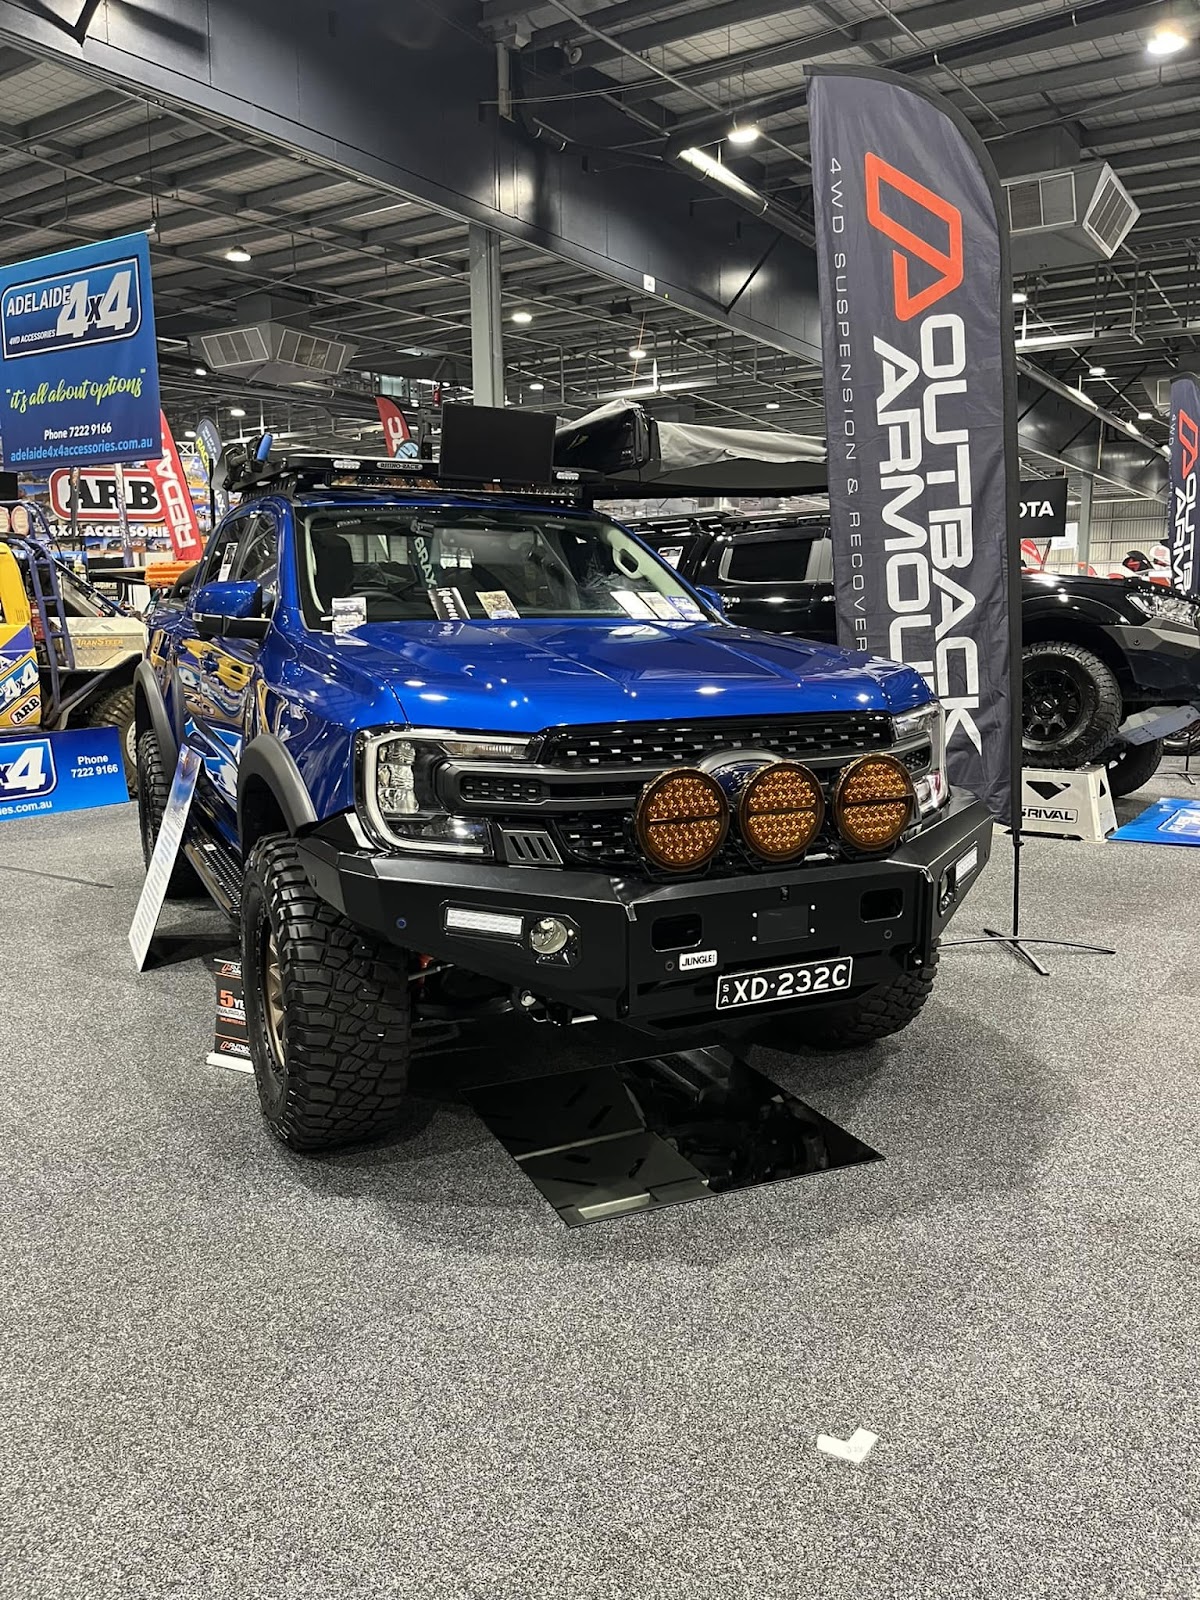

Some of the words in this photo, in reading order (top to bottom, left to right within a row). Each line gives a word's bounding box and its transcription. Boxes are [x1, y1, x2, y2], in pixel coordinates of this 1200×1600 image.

[829, 157, 845, 234] 4WD
[6, 284, 72, 317] ADELAIDE
[20, 329, 56, 344] ACCESSORIES
[834, 253, 857, 460] SUSPENSION
[29, 382, 49, 406] all
[48, 379, 91, 403] about
[44, 428, 68, 440] Phone
[69, 426, 90, 438] 7222
[91, 422, 112, 434] 9166
[10, 437, 153, 462] adelaide4x4accessories.com.au
[65, 479, 158, 510] ARB
[846, 478, 860, 496] &
[873, 335, 935, 697] ARMOU
[85, 525, 169, 538] ACCESORIE
[919, 313, 982, 757] OUTBACK
[14, 698, 40, 722] ARB
[71, 767, 94, 778] 7222
[96, 763, 118, 775] 9166
[77, 754, 109, 766] Phone
[682, 954, 712, 967] JUNGLE
[220, 989, 234, 1008] 5
